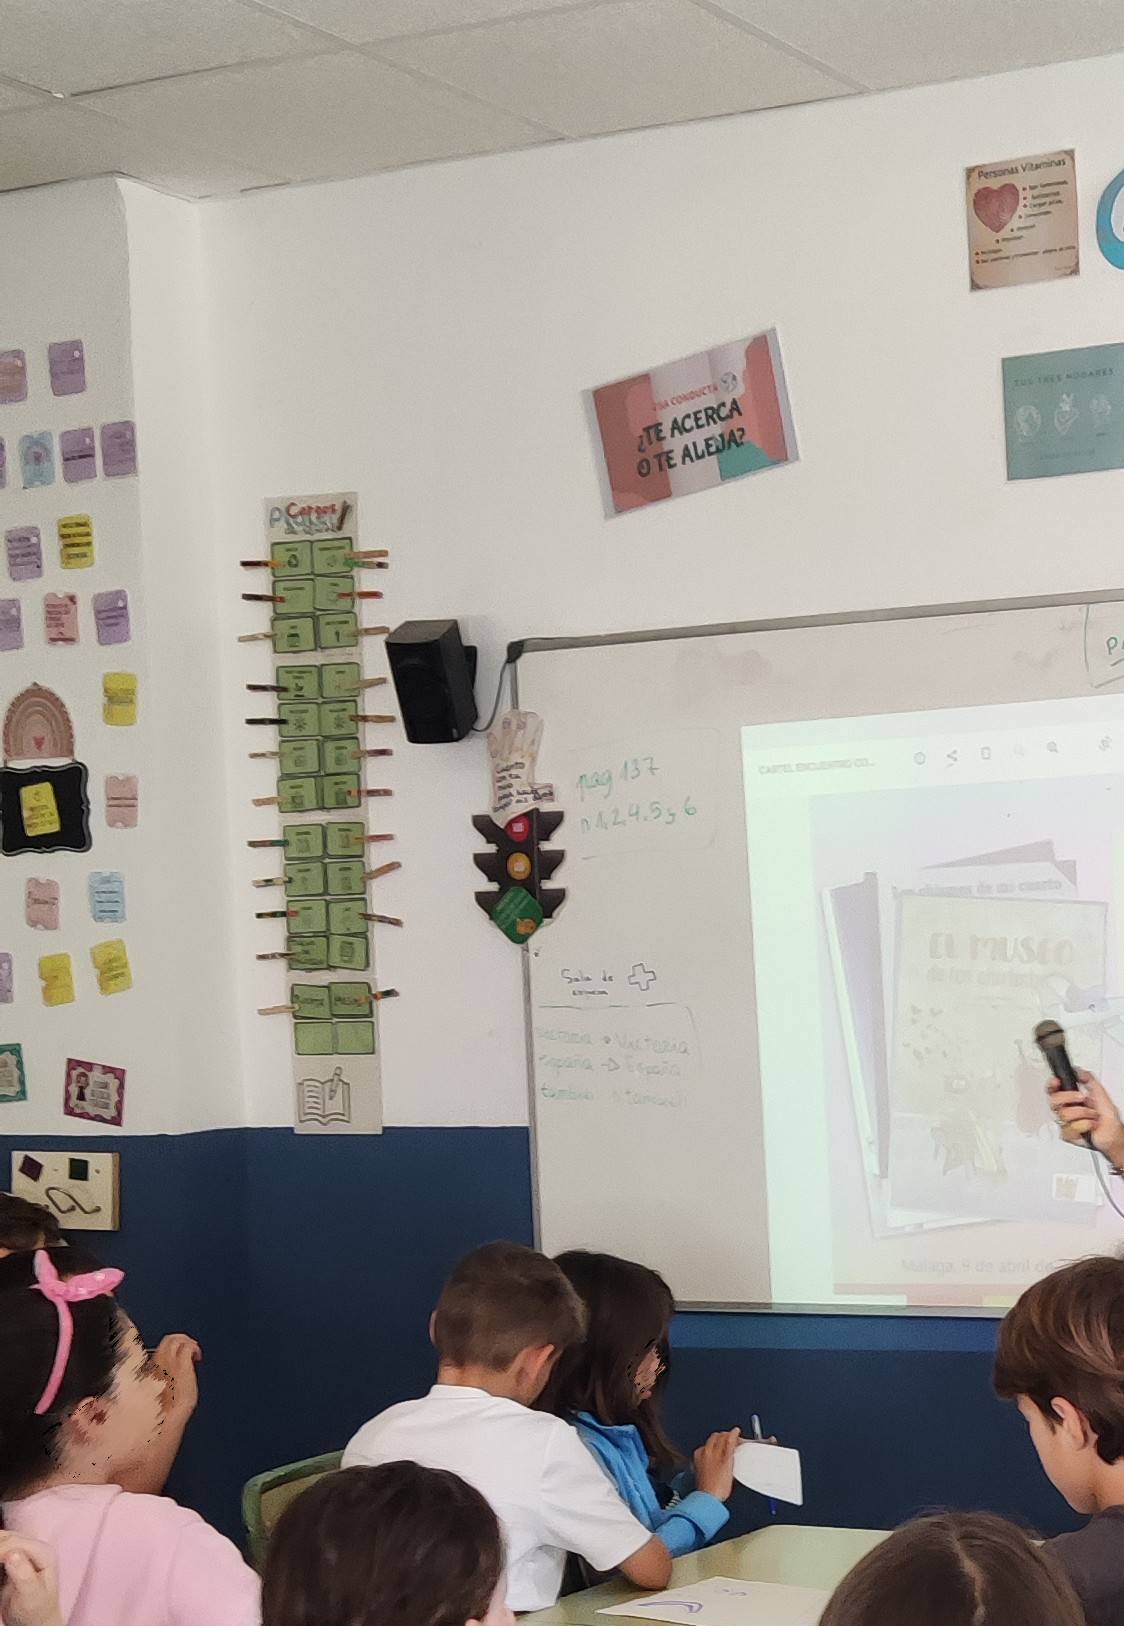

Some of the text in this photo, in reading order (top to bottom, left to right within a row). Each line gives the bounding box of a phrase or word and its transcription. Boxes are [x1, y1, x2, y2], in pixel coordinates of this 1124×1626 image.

[636, 397, 744, 454] ¿TE ACERCA
[636, 427, 746, 478] O TE ALEJA?
